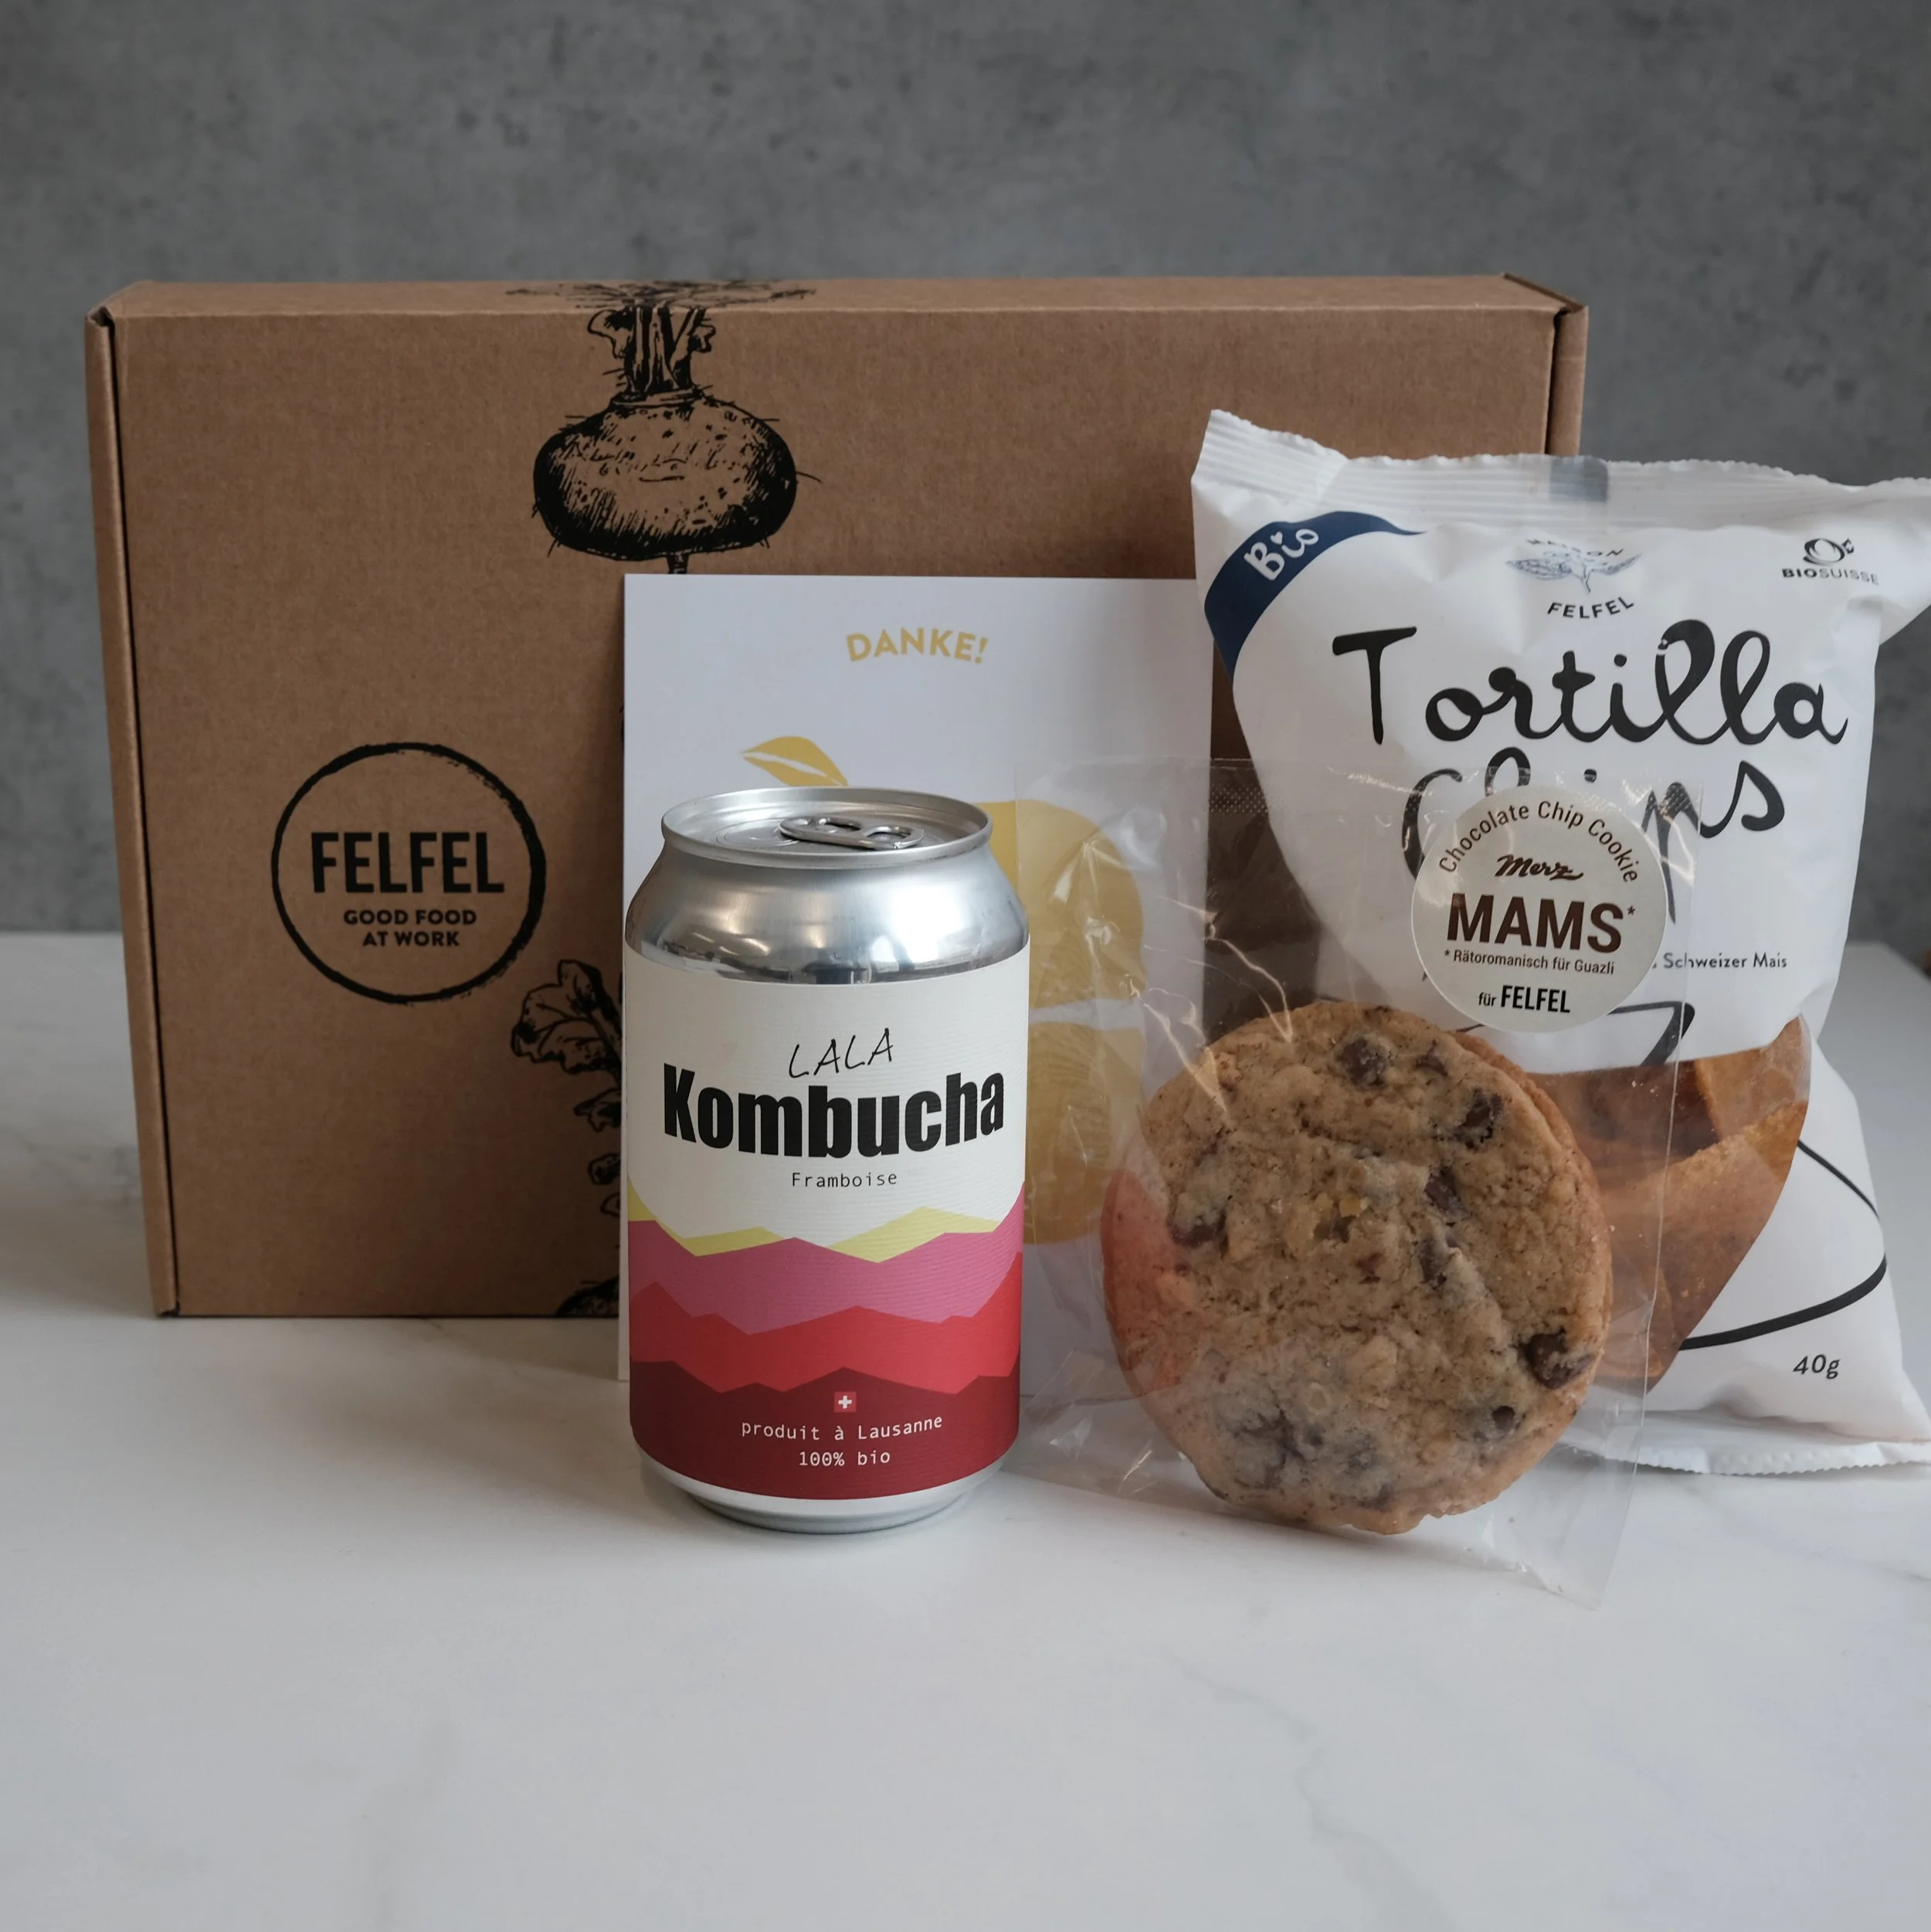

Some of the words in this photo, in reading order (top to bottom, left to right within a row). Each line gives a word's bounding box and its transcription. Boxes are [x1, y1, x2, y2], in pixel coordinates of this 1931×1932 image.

[1243, 528, 1319, 581] Bio
[1547, 596, 1634, 619] FELFEL
[846, 626, 988, 664] DANKE!
[1332, 619, 1848, 745] Tortilla
[1439, 804, 1529, 873] Chocolate
[1538, 801, 1583, 829] Chip
[1588, 819, 1638, 883] Cookie
[311, 832, 504, 893] FELFEL
[344, 910, 409, 925] GOOD
[416, 910, 477, 925] FOOD
[363, 932, 388, 946] AT
[395, 932, 460, 946] WORK
[1454, 949, 1548, 969] Rätoromanisch
[1553, 956, 1571, 971] für
[1575, 959, 1614, 975] Guazli
[1663, 952, 1747, 968] Schweizer
[1753, 952, 1787, 968] Mais
[1478, 992, 1496, 1007] für
[1501, 985, 1570, 1013] FELFEL
[789, 1027, 894, 1078] LALA
[663, 1062, 1004, 1158] Kombucha
[791, 1170, 897, 1187] Framboise
[1793, 1354, 1841, 1380] 40g
[742, 1422, 820, 1441] produit
[834, 1425, 844, 1441] à
[858, 1416, 942, 1440] Lausanne
[799, 1451, 845, 1466] 100%
[857, 1450, 891, 1465] bio
